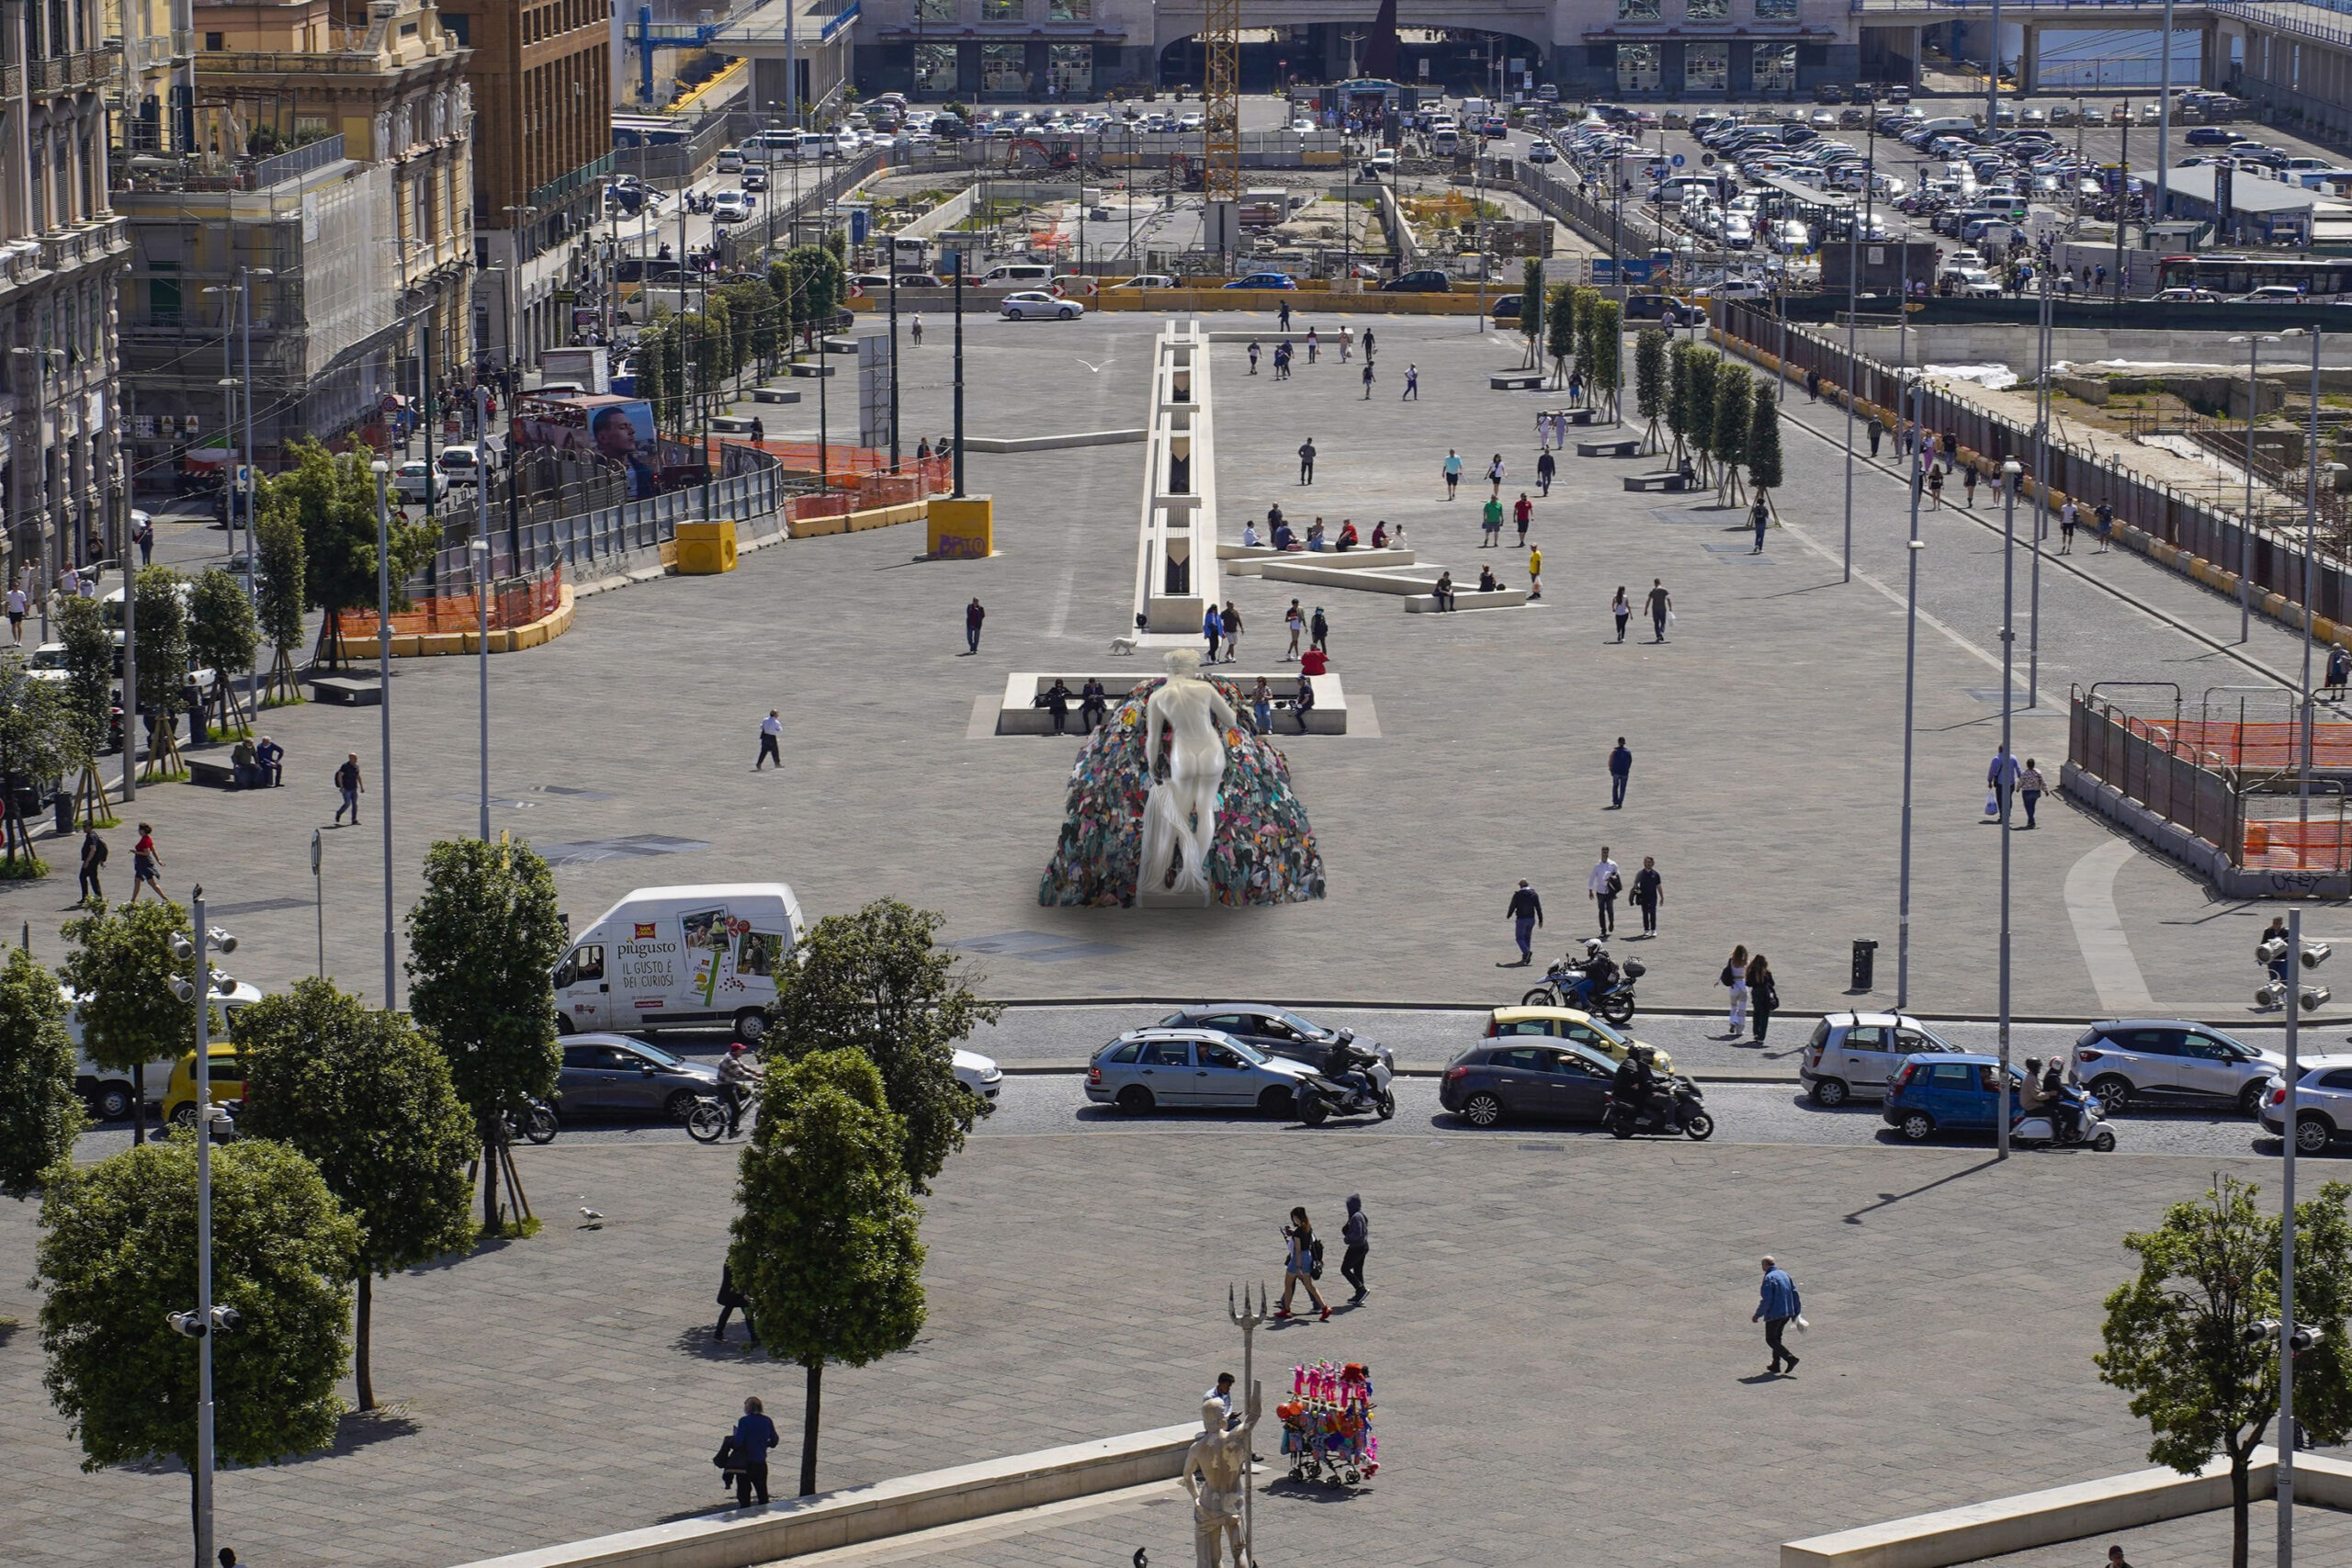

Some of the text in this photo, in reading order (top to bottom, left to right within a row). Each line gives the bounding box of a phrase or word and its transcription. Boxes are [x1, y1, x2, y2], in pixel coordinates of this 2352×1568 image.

[617, 939, 676, 959] piùgusto
[623, 963, 631, 975] IL
[634, 961, 662, 975] GUSTO
[623, 974, 673, 988] DEI CURIOSI
